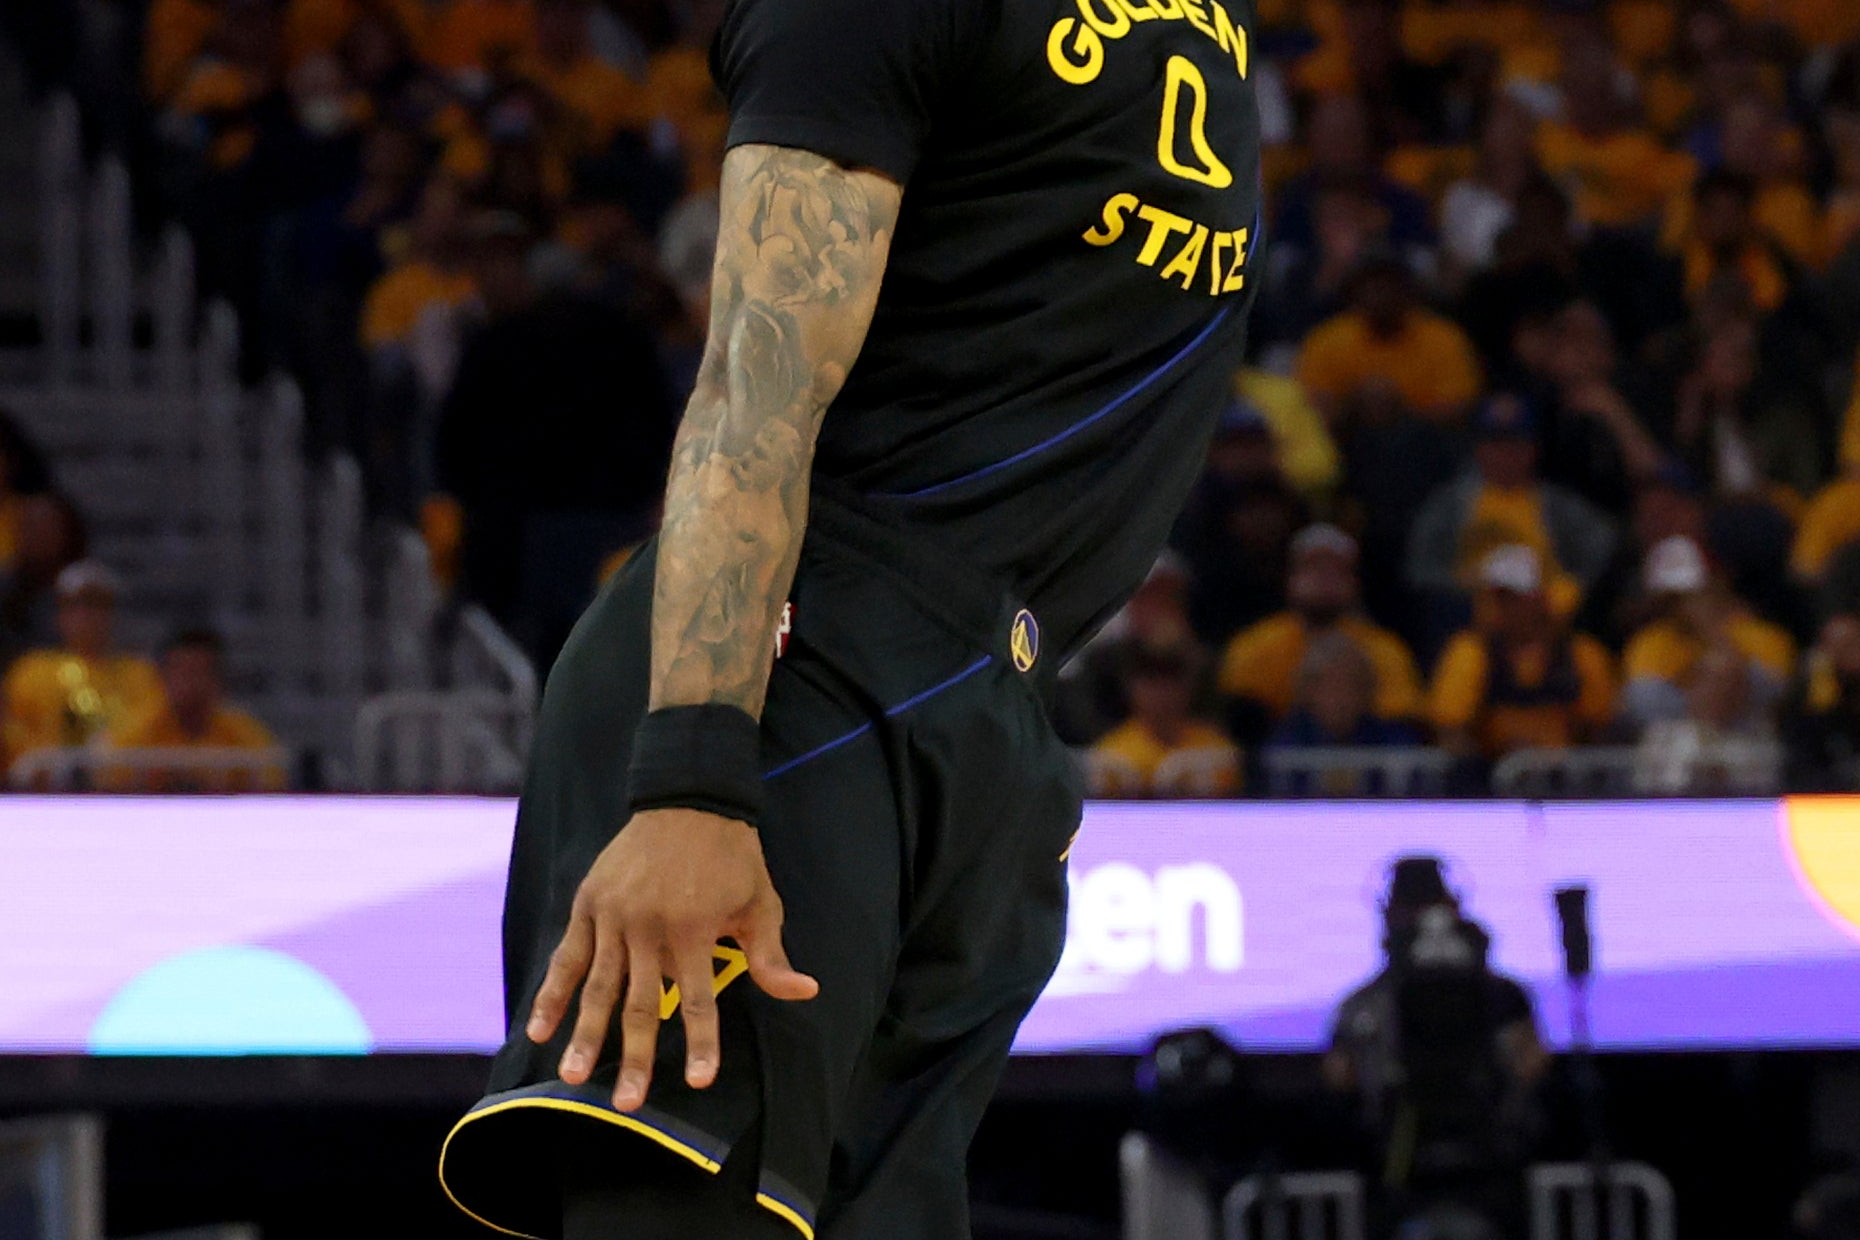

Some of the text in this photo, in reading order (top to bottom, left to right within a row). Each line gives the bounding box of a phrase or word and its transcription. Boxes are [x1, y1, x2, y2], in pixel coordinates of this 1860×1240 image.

[1157, 54, 1234, 189] 0
[1081, 192, 1248, 296] STATE
[1067, 862, 1243, 974] en
